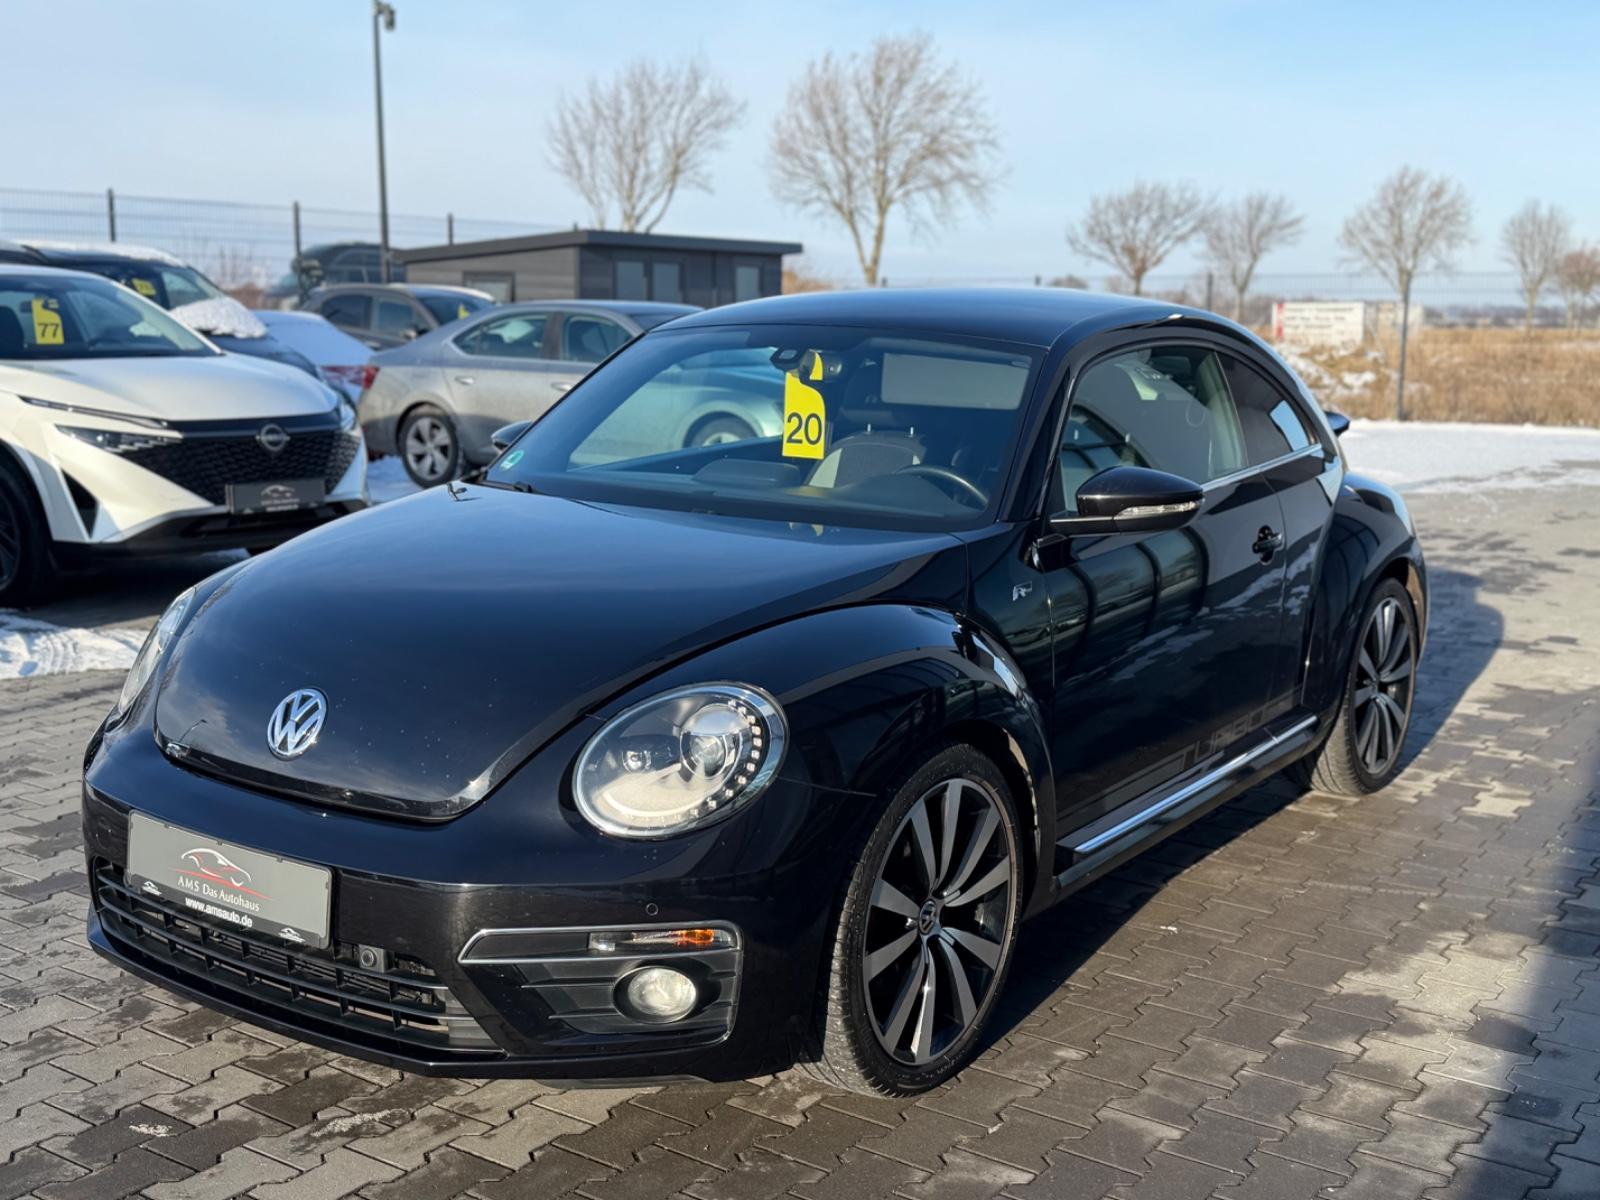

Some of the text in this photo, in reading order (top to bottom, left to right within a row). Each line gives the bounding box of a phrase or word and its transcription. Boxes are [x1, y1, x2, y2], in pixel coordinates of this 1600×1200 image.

[37, 322, 60, 339] 77
[786, 412, 823, 446] 20
[267, 688, 327, 757] VW
[177, 876, 260, 912] AMS Das Autohaus
[185, 897, 253, 927] www.amsauto.de
